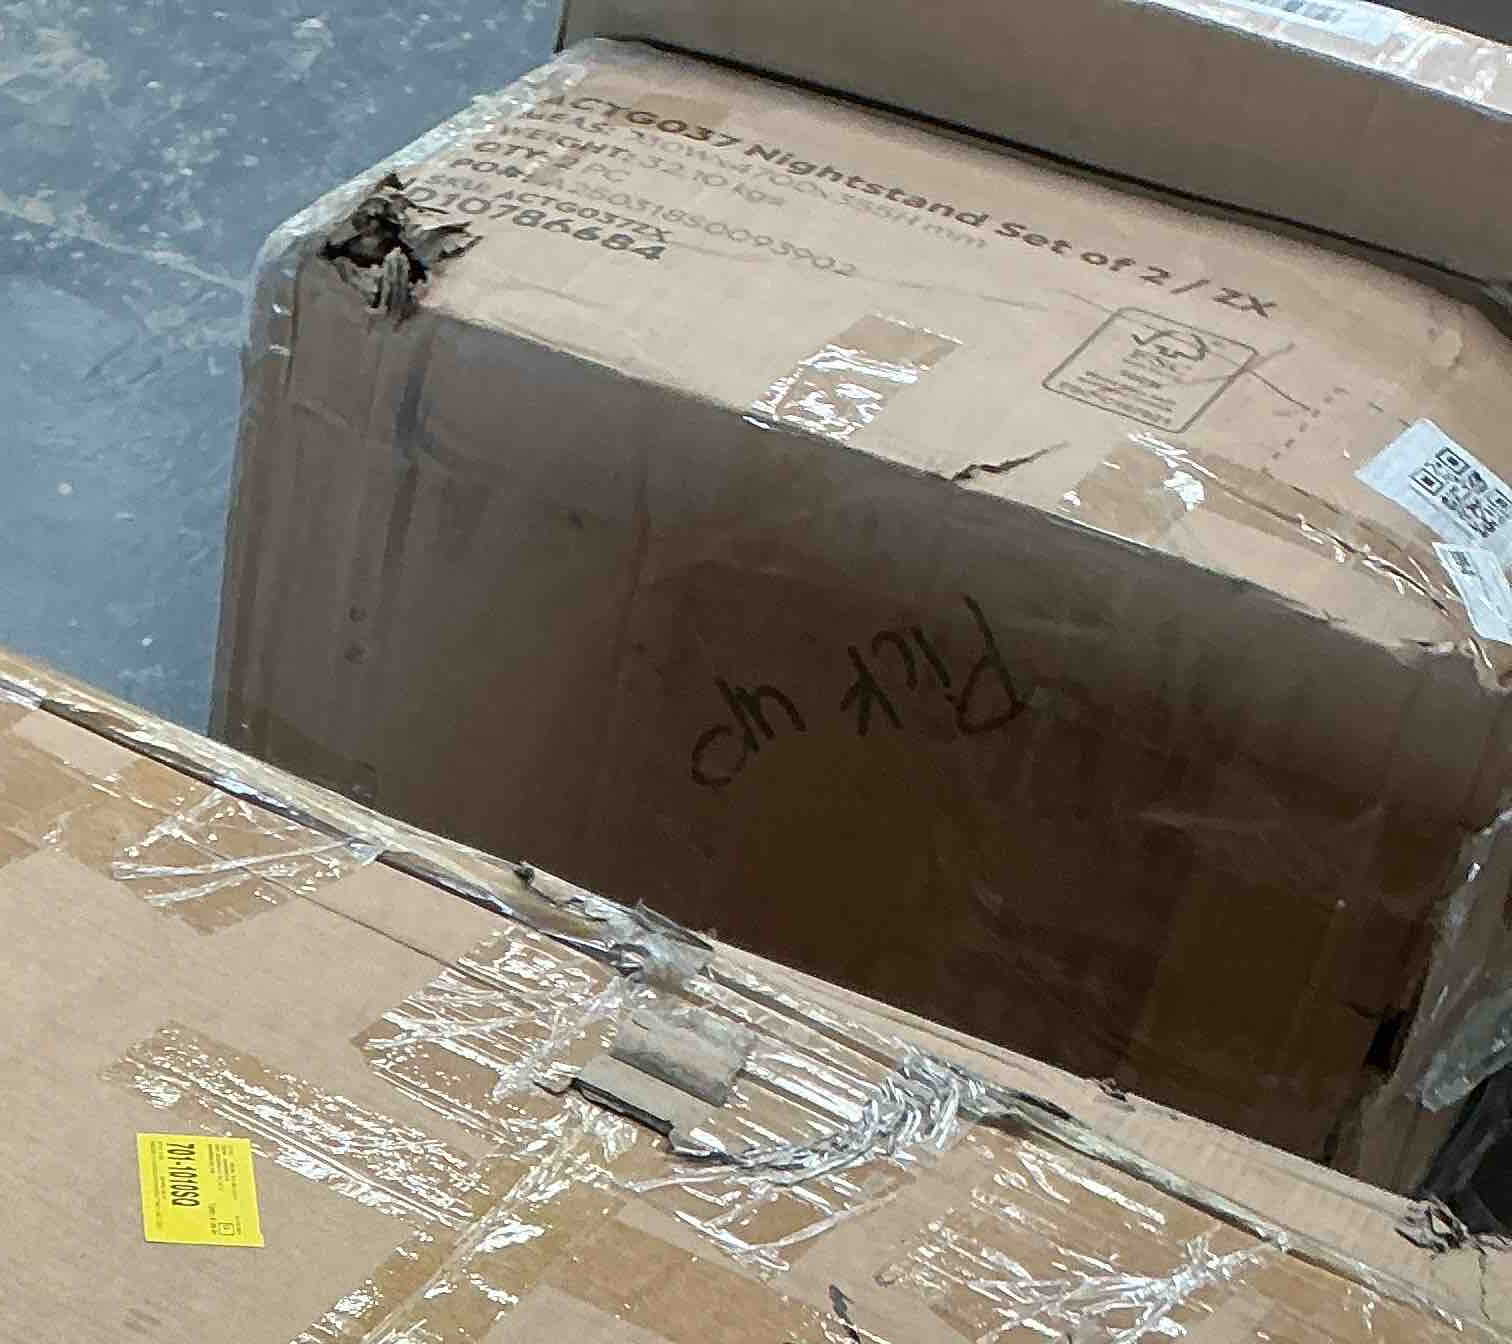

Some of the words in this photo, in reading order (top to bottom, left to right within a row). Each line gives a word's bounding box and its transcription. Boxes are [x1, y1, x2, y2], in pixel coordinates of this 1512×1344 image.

[744, 143, 988, 228] Nightstand
[995, 221, 1073, 255] Set
[1080, 251, 1137, 272] of
[840, 592, 1029, 736] Pick
